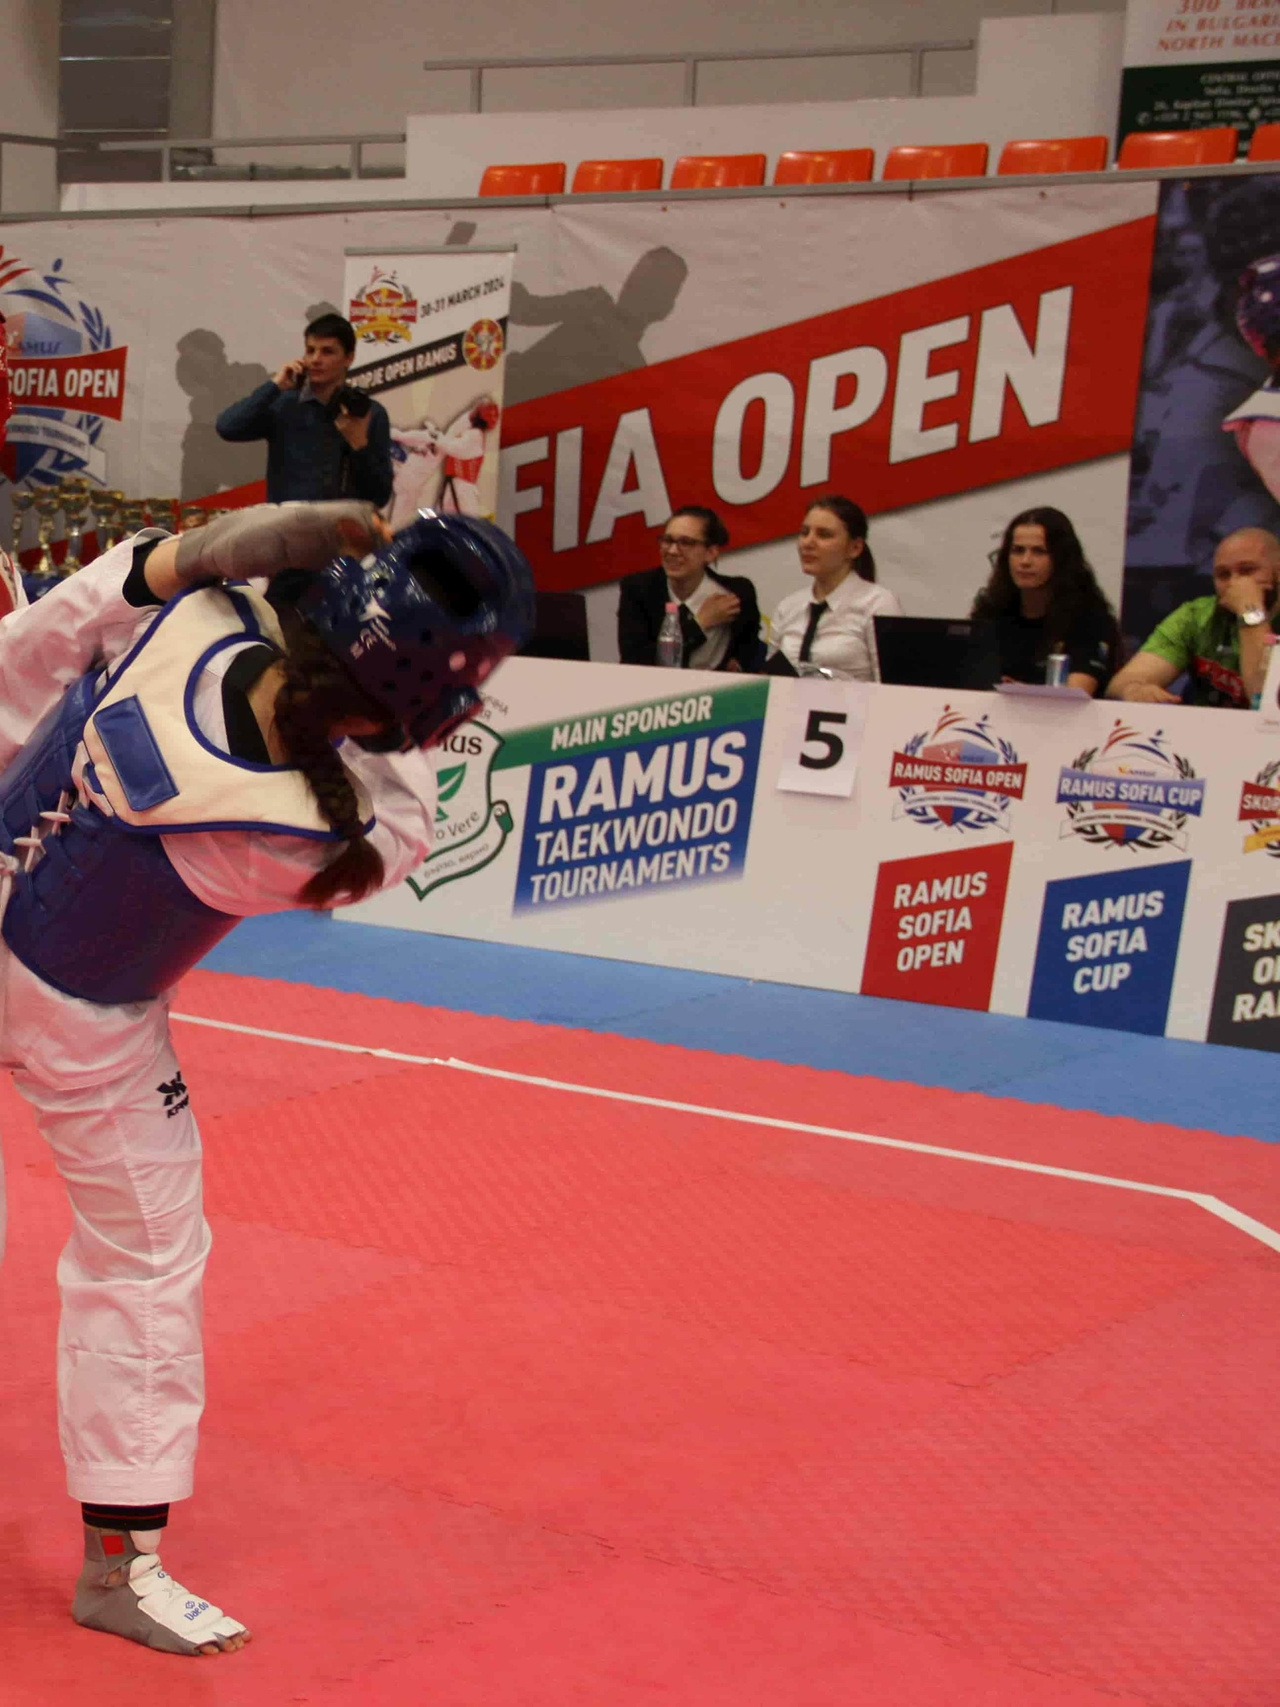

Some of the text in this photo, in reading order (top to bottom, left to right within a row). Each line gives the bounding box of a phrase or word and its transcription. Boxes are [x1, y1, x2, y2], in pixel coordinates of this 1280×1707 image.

[447, 285, 480, 306] MARCH
[385, 357, 415, 381] OPEN
[415, 342, 457, 372] RAMUS
[63, 368, 120, 398] OPEN
[712, 284, 1074, 506] OPEN
[551, 695, 714, 751] MAIN SPONSOR
[798, 709, 848, 771] 5
[538, 730, 747, 824] RAMUS
[893, 761, 1023, 789] RAMUS SOFIA OPEN
[1060, 777, 1202, 806] RAMUS SOFIA CUP
[534, 797, 739, 867] TAEKWONDO
[530, 841, 731, 904] TOURNAMENTS
[893, 871, 988, 909] RAMUS
[897, 906, 972, 940] SOFIA
[1061, 890, 1166, 930] RAMUS
[896, 939, 965, 972] OPEN
[1065, 926, 1148, 962] SOFIA
[1073, 961, 1132, 995] CUP
[1232, 989, 1280, 1022] RA
